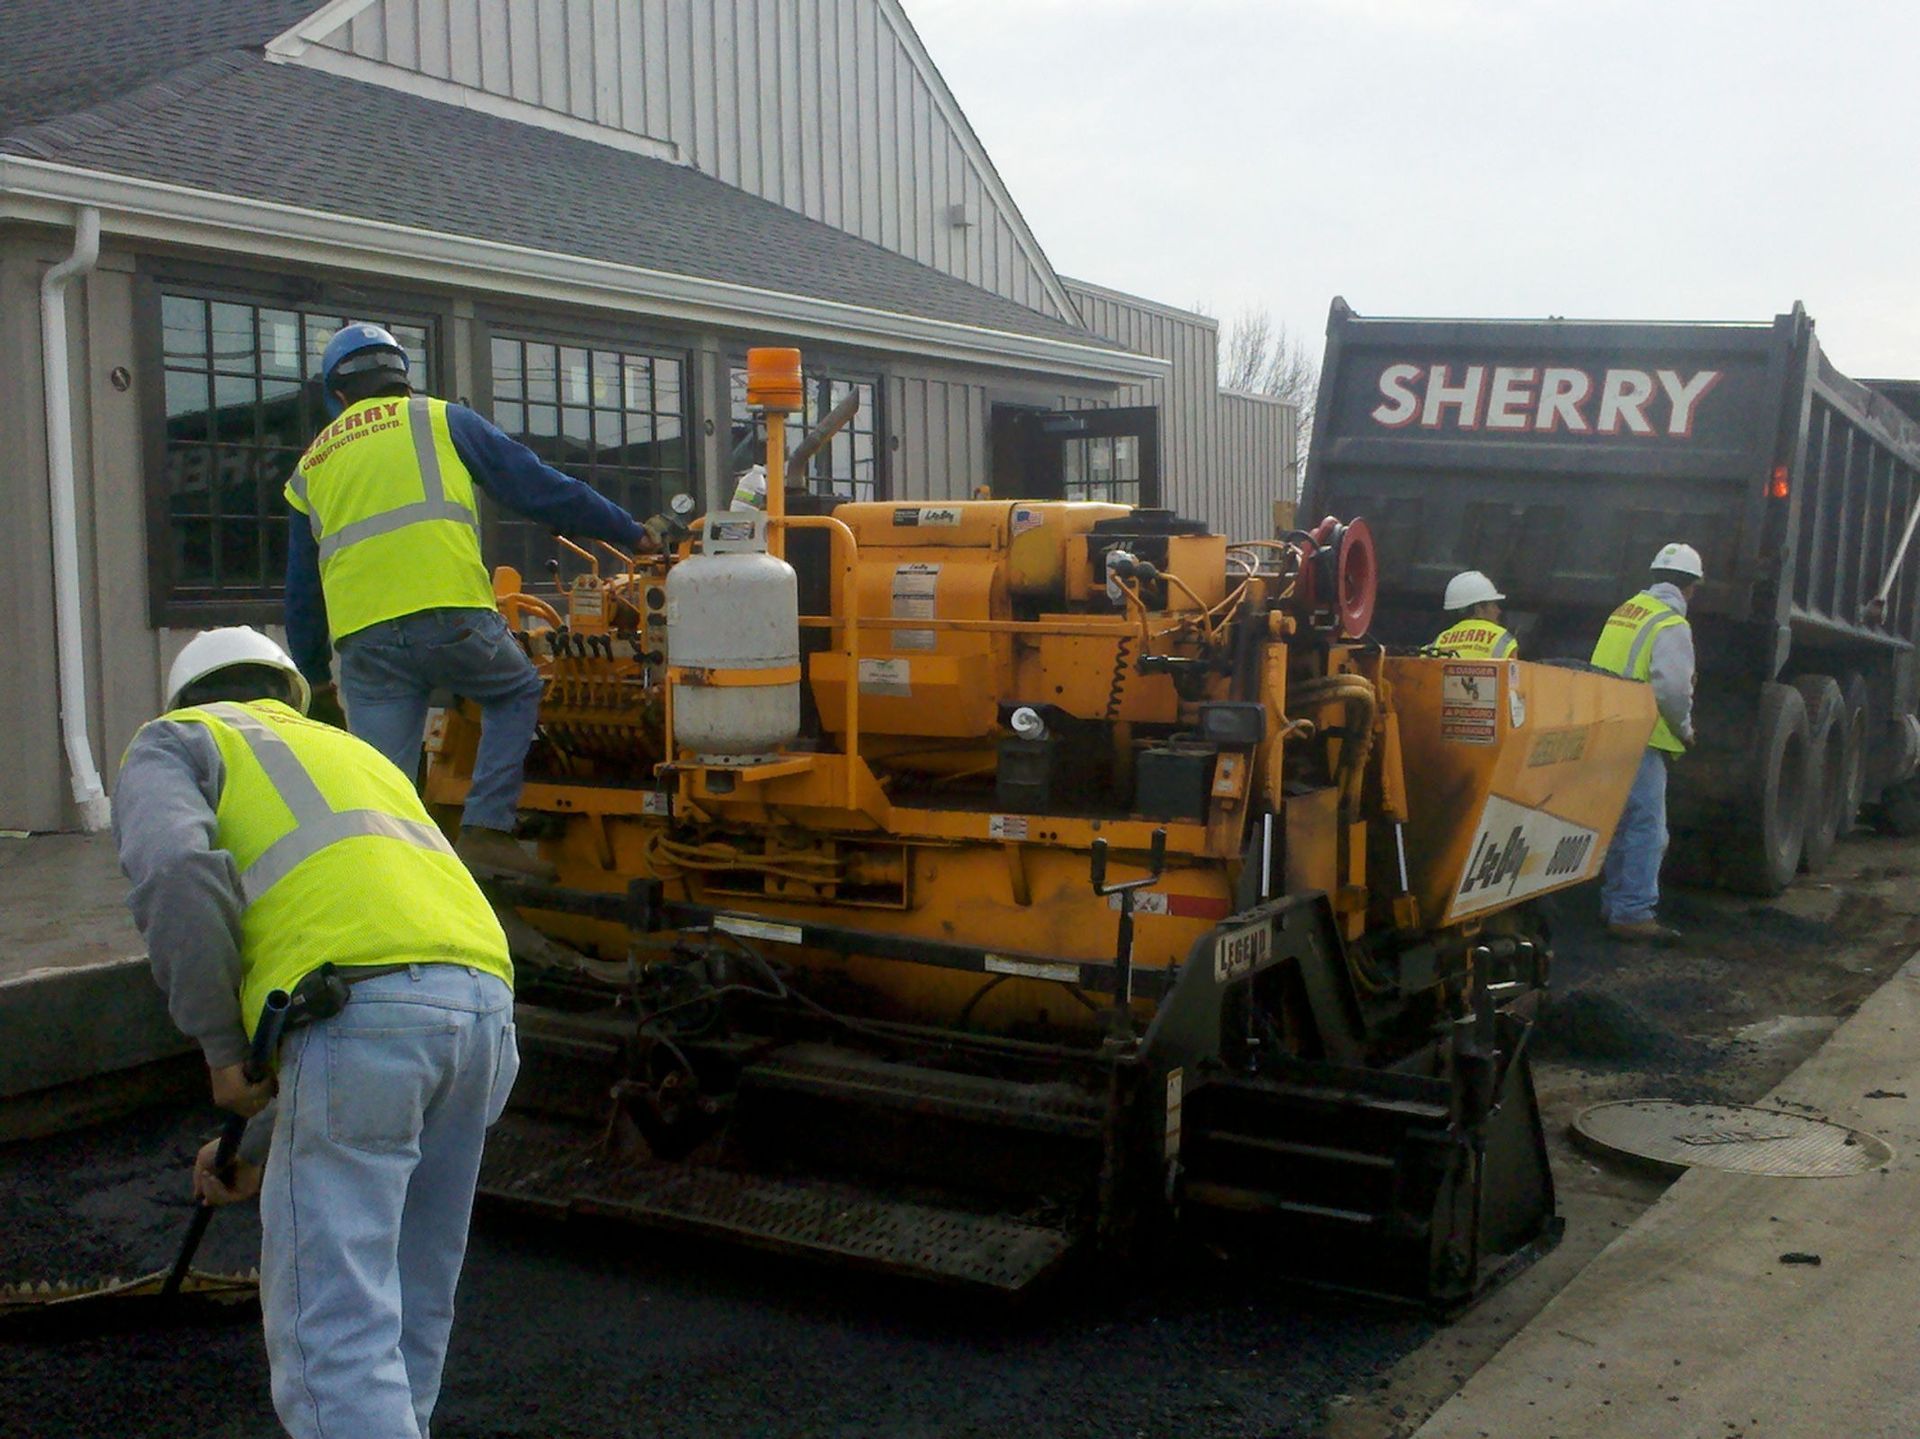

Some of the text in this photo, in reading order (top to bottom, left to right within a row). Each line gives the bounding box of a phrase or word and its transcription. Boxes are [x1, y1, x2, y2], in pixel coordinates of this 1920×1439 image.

[1371, 363, 1723, 437] SHERRY
[1440, 629, 1497, 645] SHERRY
[1455, 667, 1495, 676] DANGER
[1460, 826, 1530, 896] LeeBoy
[1220, 928, 1266, 972] LEGEND
